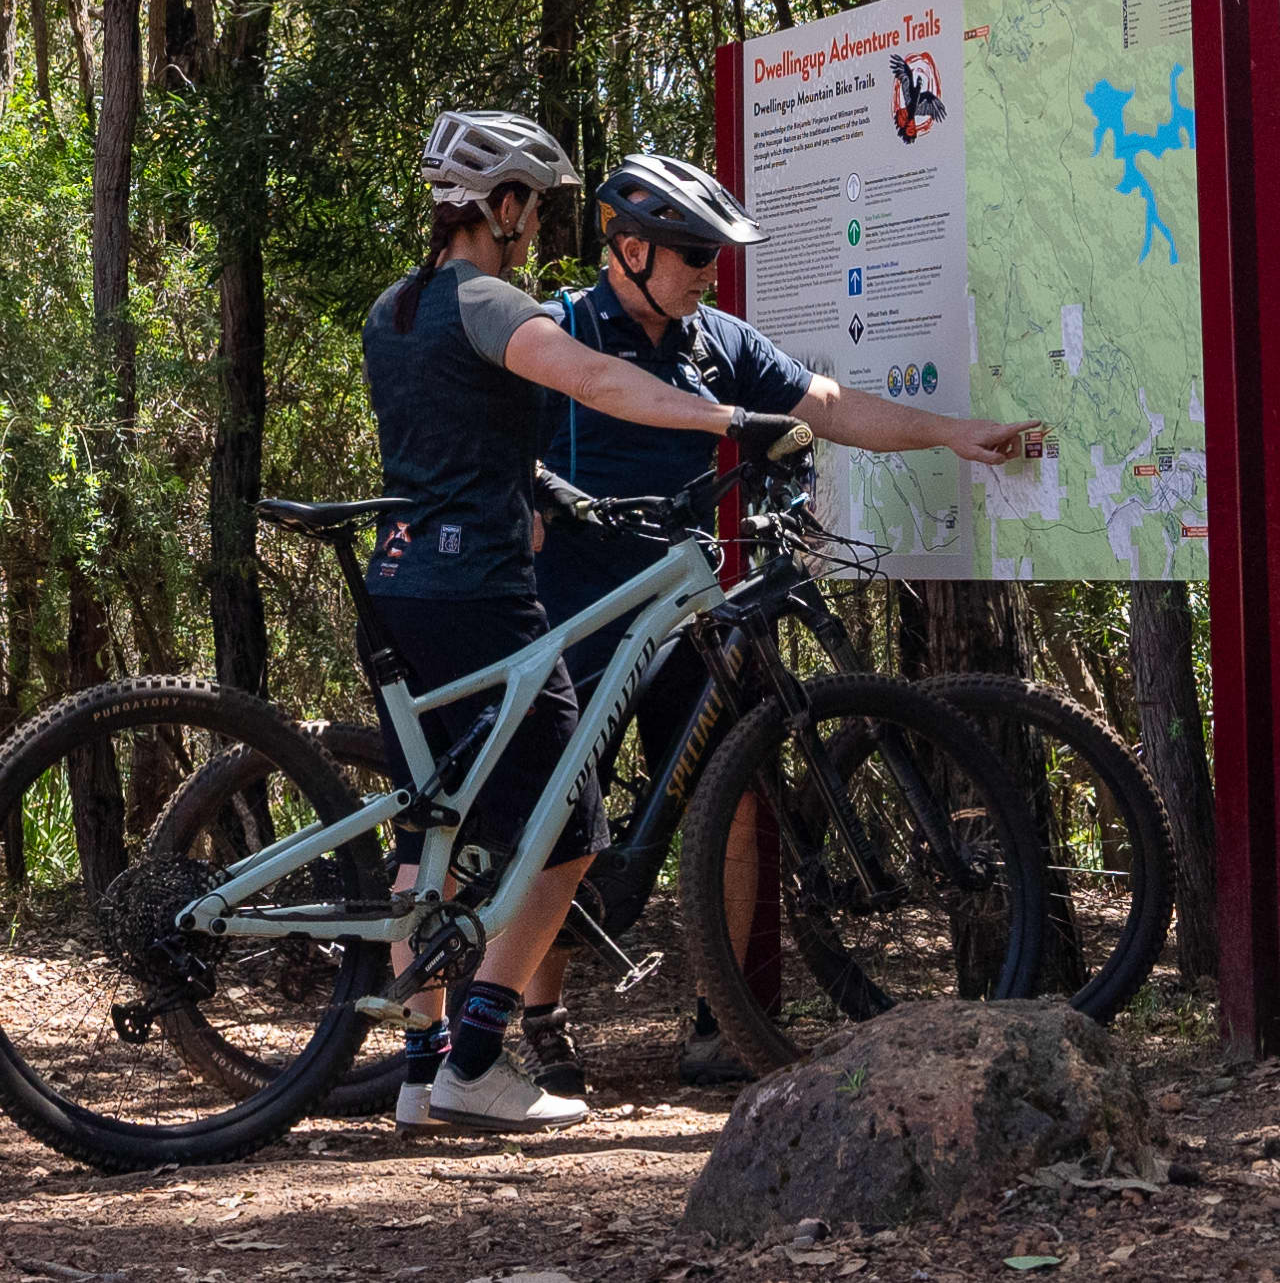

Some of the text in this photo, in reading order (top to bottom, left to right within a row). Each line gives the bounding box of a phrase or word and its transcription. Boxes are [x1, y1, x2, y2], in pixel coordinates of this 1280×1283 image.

[754, 50, 825, 83] Dwellingup
[829, 30, 899, 63] Adventure
[903, 9, 940, 42] Trails
[754, 73, 875, 116] Dwellingup Mountain Bike Trails
[93, 697, 180, 722] PURGATORY
[566, 637, 655, 806] SPECIALIZED
[666, 644, 743, 797] SPECIALID
